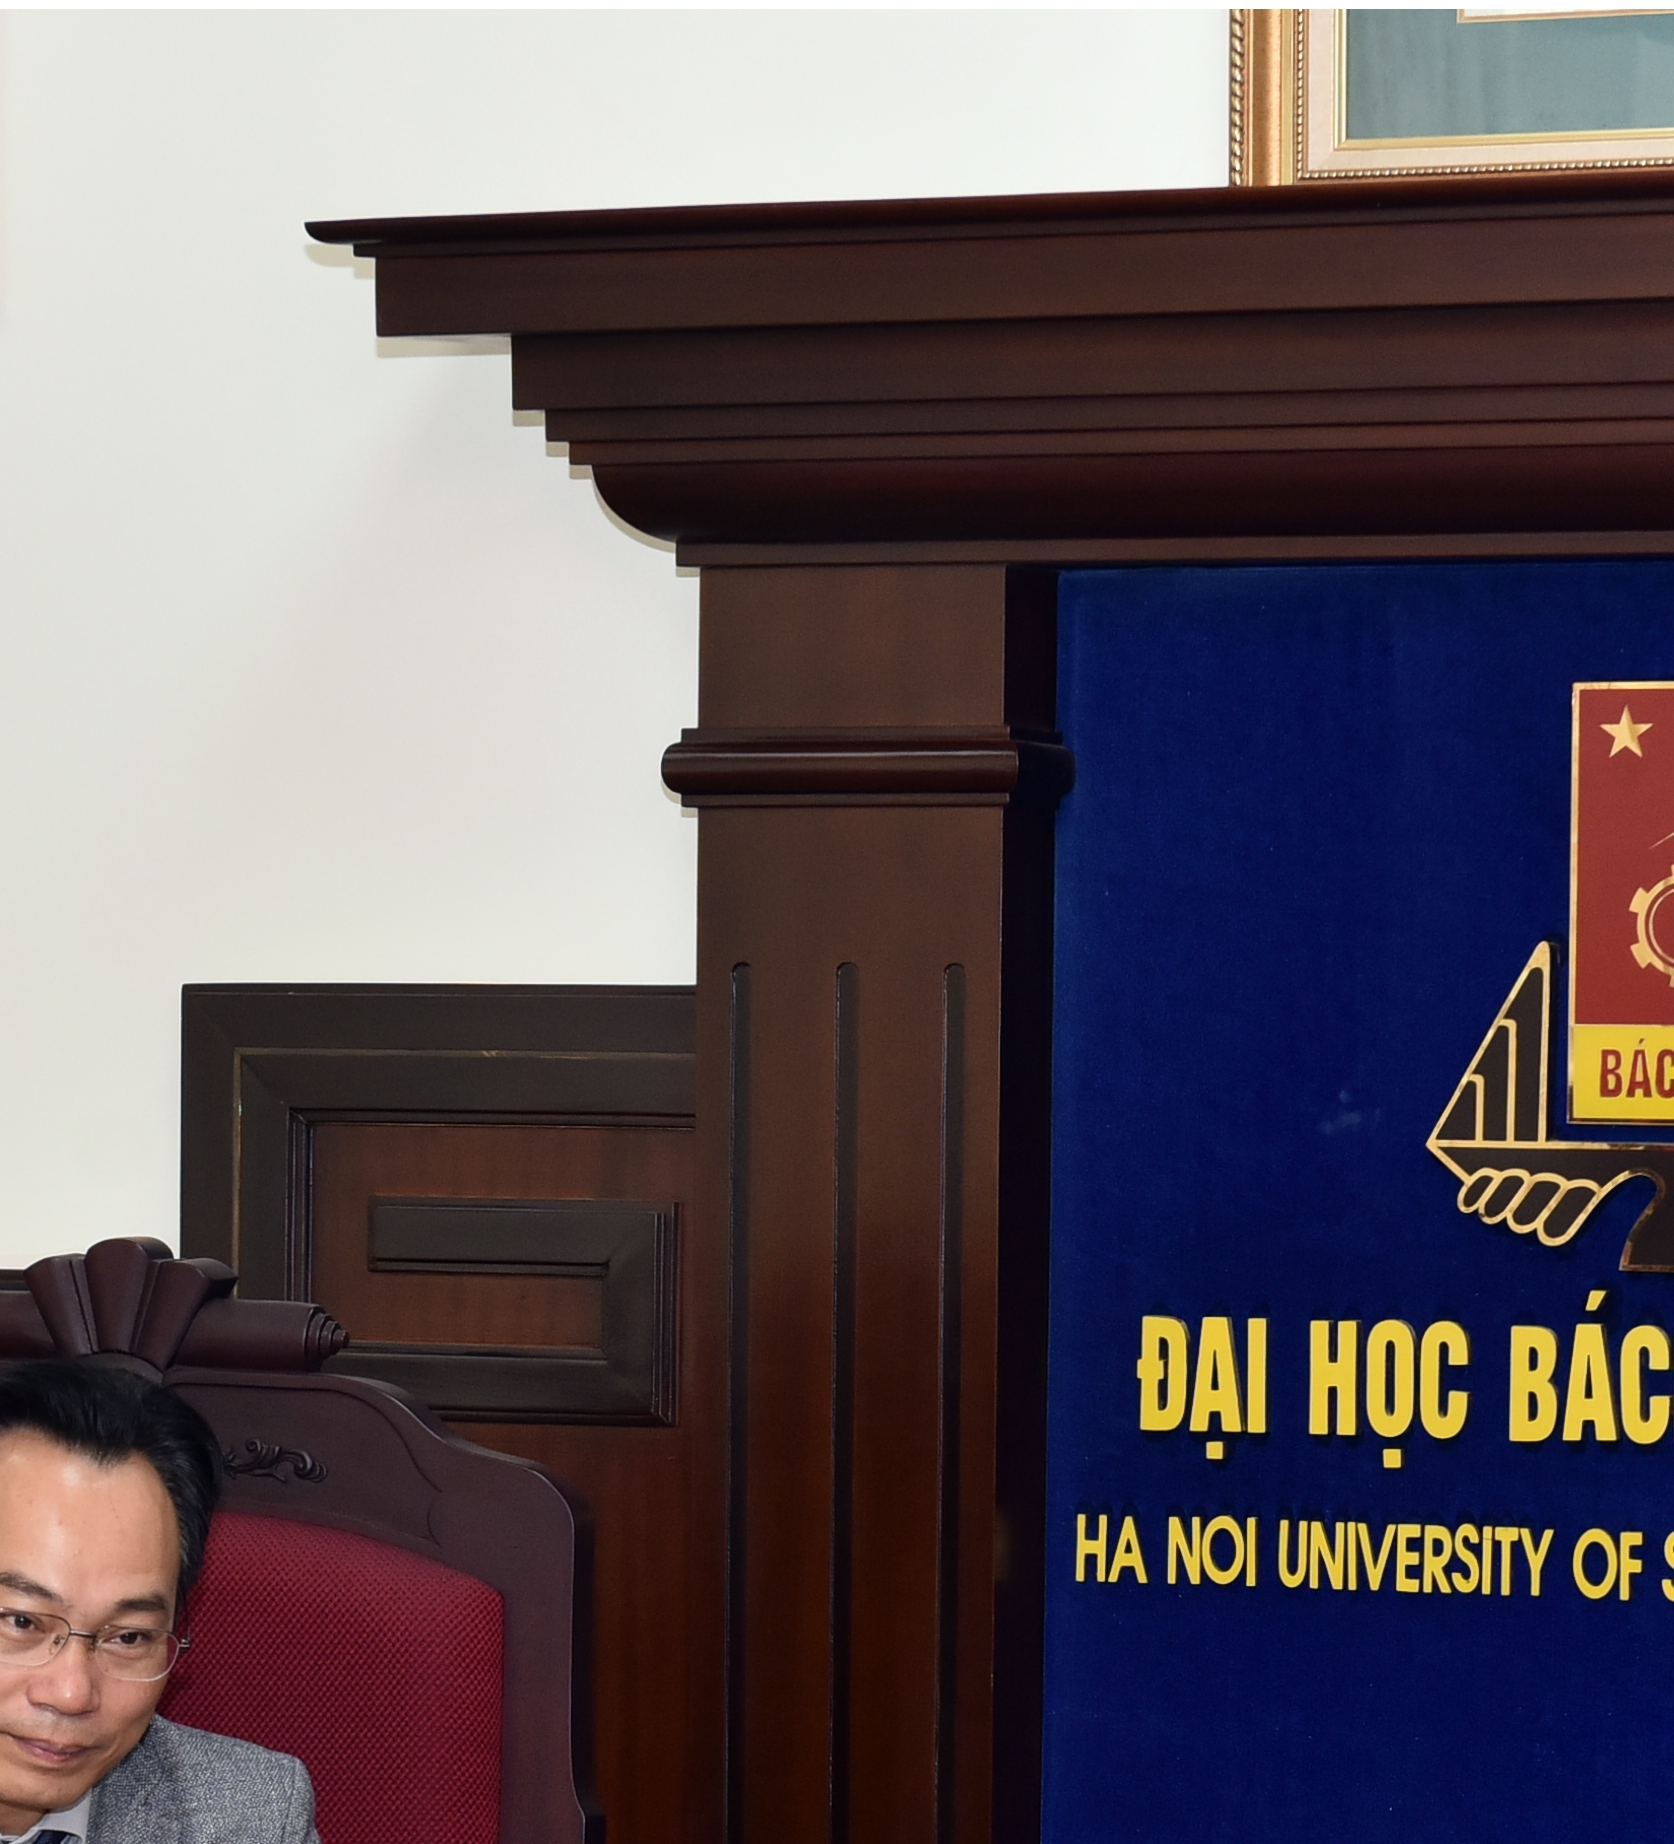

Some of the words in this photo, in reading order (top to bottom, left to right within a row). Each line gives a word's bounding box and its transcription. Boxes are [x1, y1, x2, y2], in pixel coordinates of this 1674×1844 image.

[1137, 1315, 1267, 1460] ĐẠI
[1309, 1319, 1469, 1469] HỌC
[1076, 1513, 1148, 1584] HA
[1168, 1515, 1256, 1586] NOI
[1279, 1519, 1554, 1597] UNIVERSITY
[1573, 1528, 1643, 1601] OF
